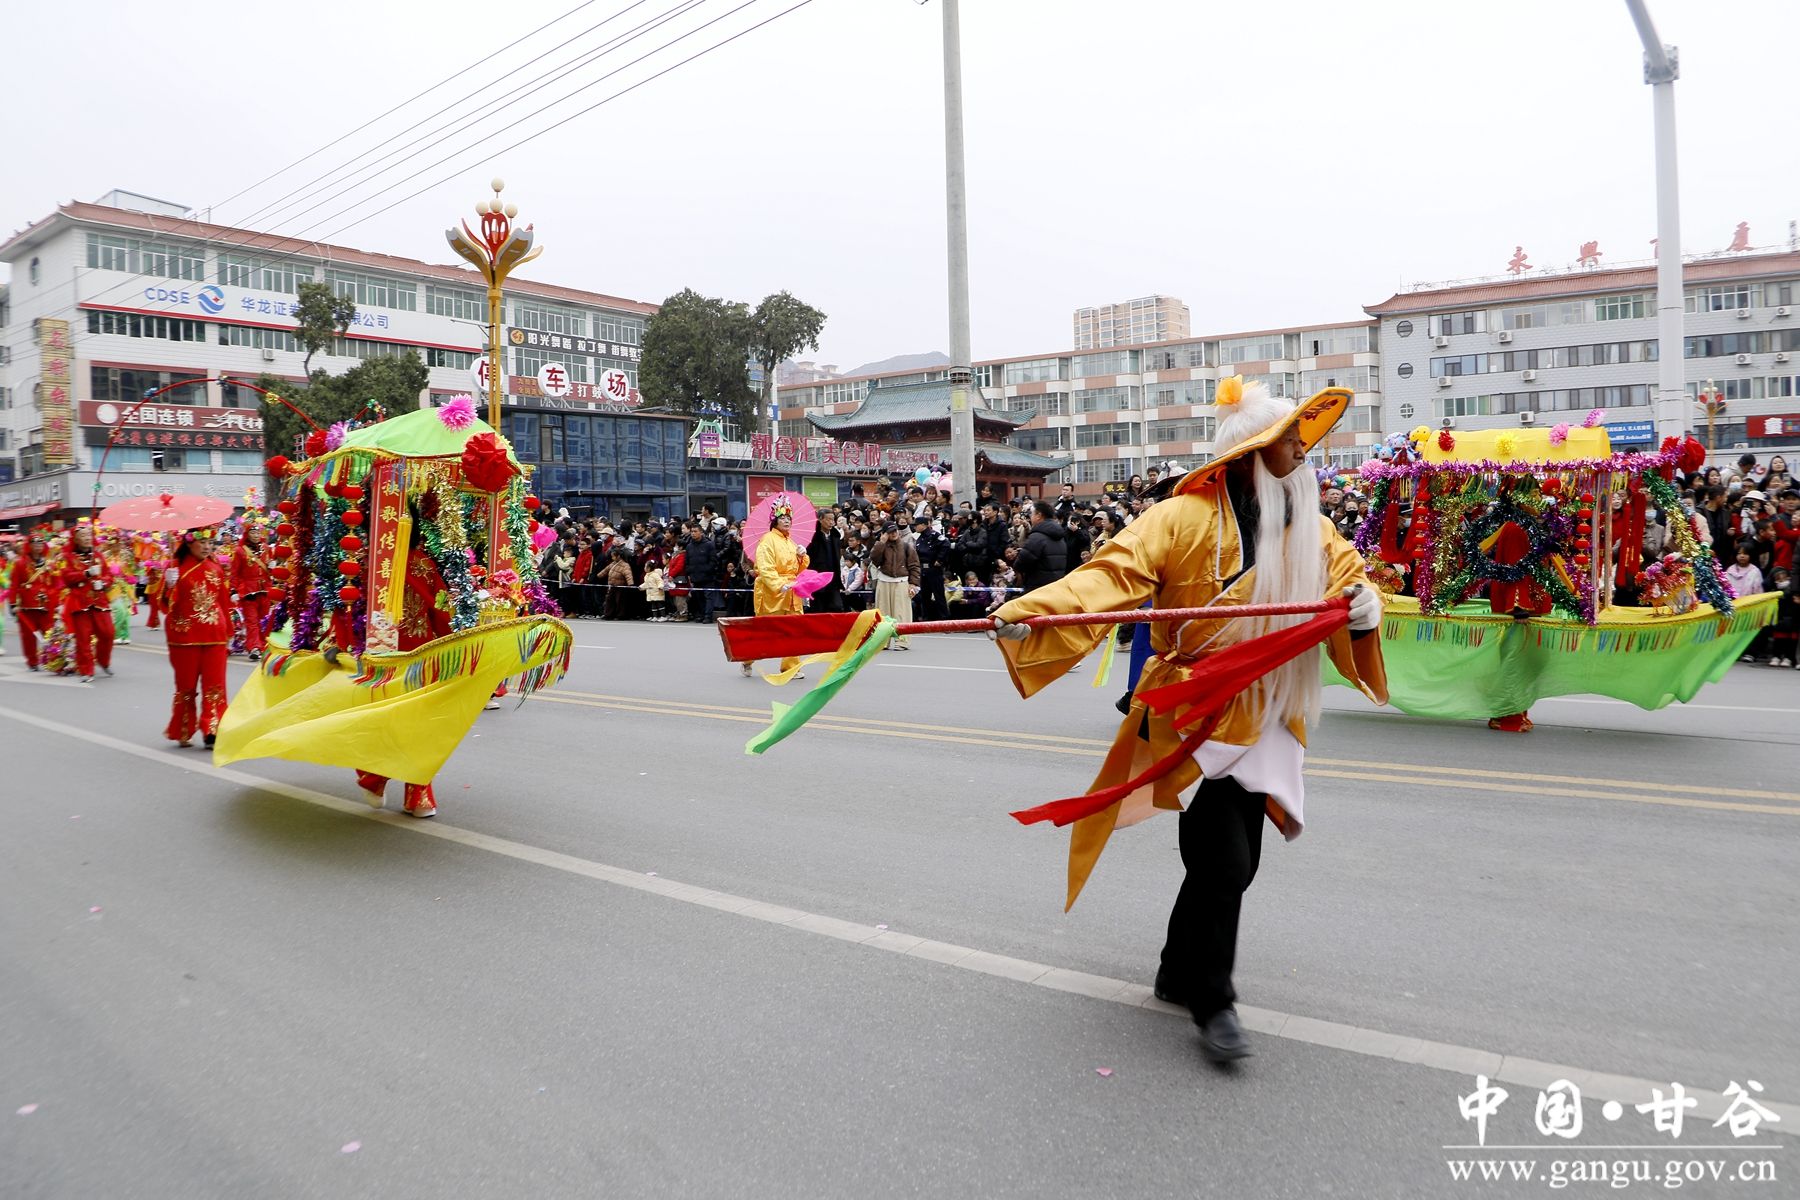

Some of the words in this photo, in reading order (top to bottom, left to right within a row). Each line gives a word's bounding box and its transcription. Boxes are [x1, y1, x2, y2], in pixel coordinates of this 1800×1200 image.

[144, 287, 190, 305] CDSE
[241, 296, 389, 329] 华龙证券限公司
[527, 332, 572, 350] 阳光舞蹈
[577, 339, 607, 354] 拉丁舞
[478, 360, 627, 398] 停车场
[121, 405, 194, 427] 全国连锁
